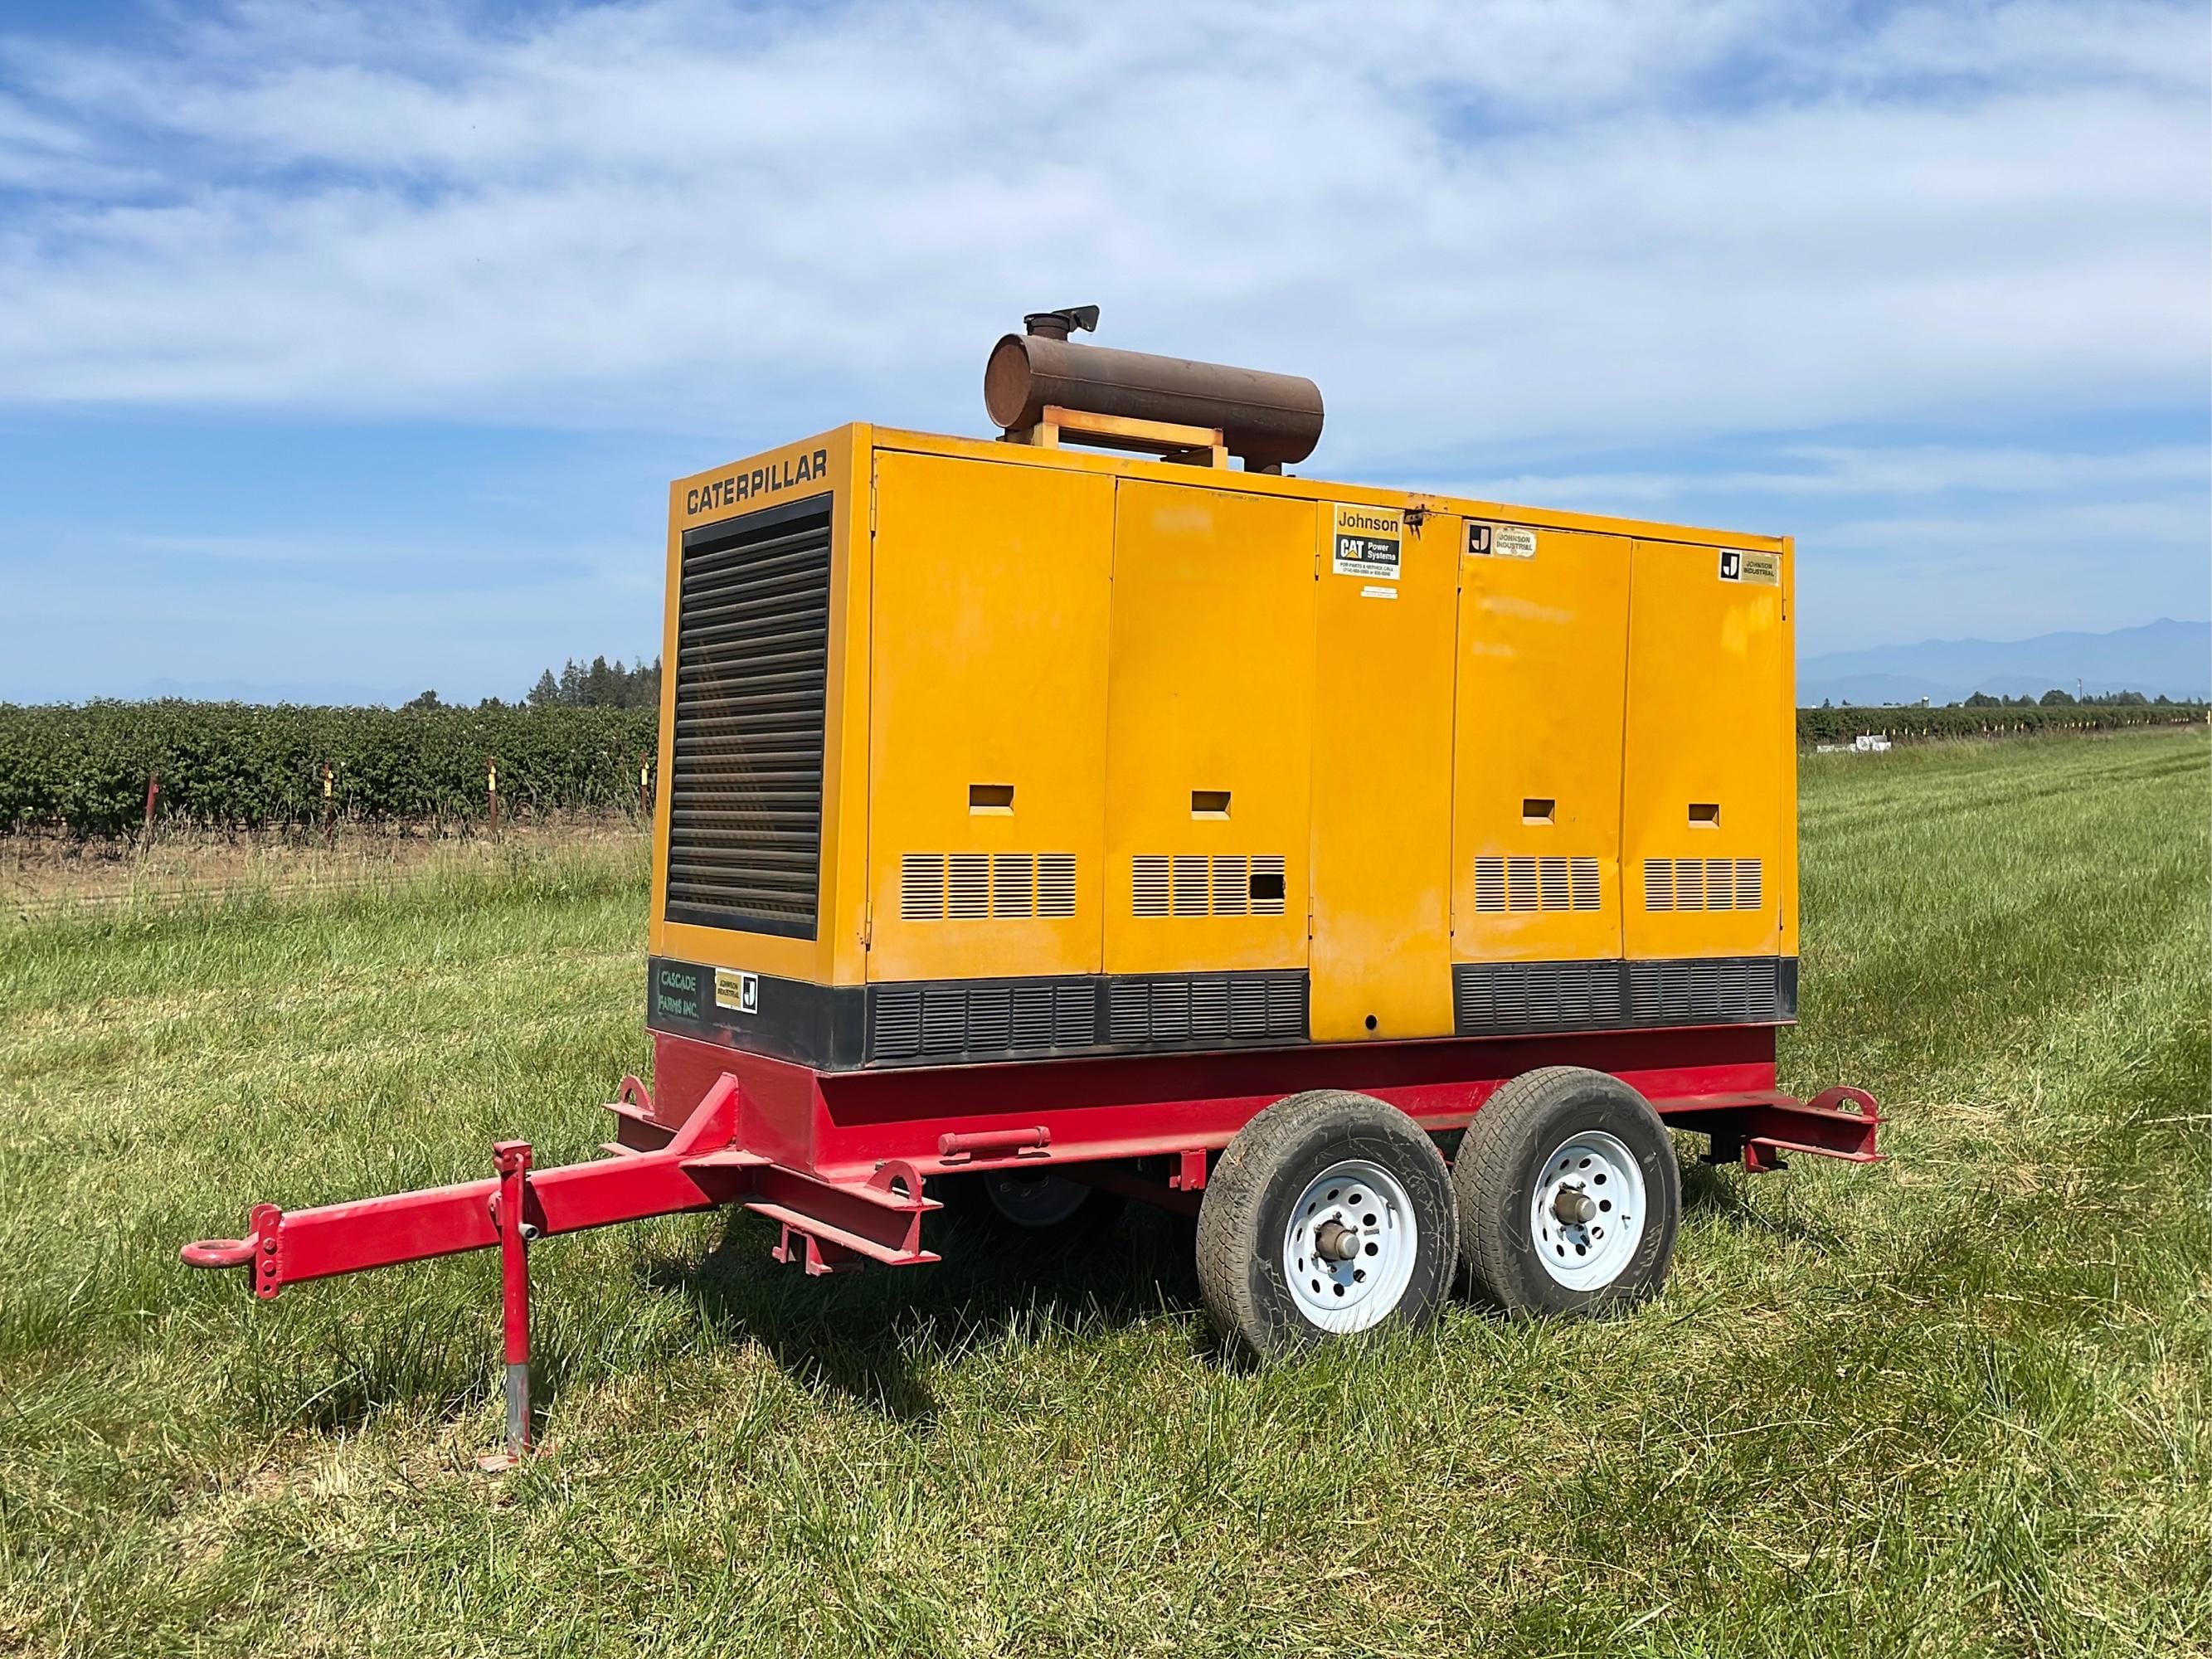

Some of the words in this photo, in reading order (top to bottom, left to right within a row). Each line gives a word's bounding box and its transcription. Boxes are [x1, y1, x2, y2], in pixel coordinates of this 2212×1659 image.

[688, 449, 827, 514] CATERPILLAR
[1339, 512, 1398, 532] Johnson
[1500, 534, 1530, 543] JOHNSON
[1340, 538, 1364, 558] CAT
[1368, 542, 1389, 552] Power
[1496, 541, 1533, 551] INDUSTRIAL
[1367, 550, 1396, 561] Systems
[1747, 561, 1772, 569] JOHNSON
[1743, 567, 1774, 577] INDUSTRIAL
[661, 971, 697, 992] CASCADE
[720, 980, 738, 990] JOHNSON
[717, 989, 740, 998] INDUSTRIAL
[659, 995, 682, 1014] FARMS
[683, 1000, 699, 1019] INC.
